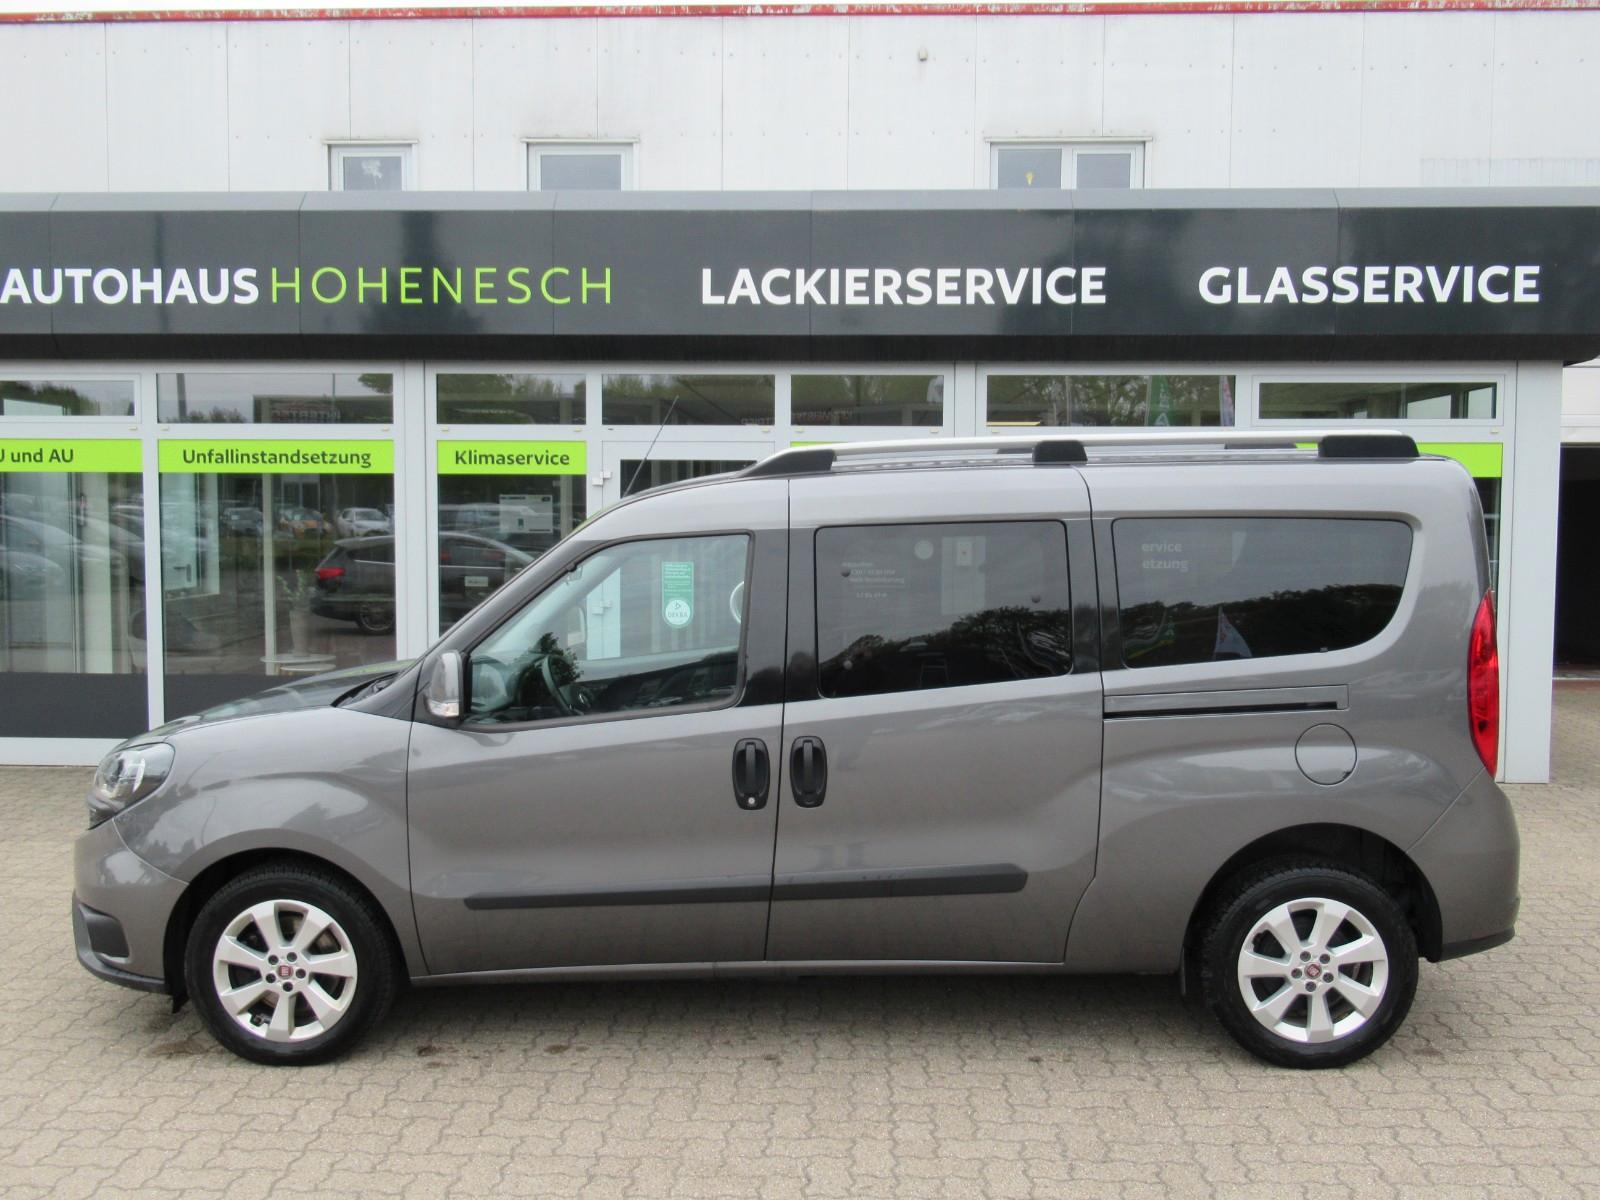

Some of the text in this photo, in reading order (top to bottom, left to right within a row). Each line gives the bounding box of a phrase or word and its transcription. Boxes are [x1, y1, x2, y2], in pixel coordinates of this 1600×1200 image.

[0, 266, 612, 305] AUTOHAUS HOHENESCH
[701, 266, 1107, 306] LACKIERSERVICE
[1198, 265, 1541, 305] GLASSERVICE
[10, 448, 43, 463] und
[48, 448, 74, 463] AU
[182, 449, 372, 469] Unfallinstandsetzung
[455, 449, 570, 466] Klimaservice
